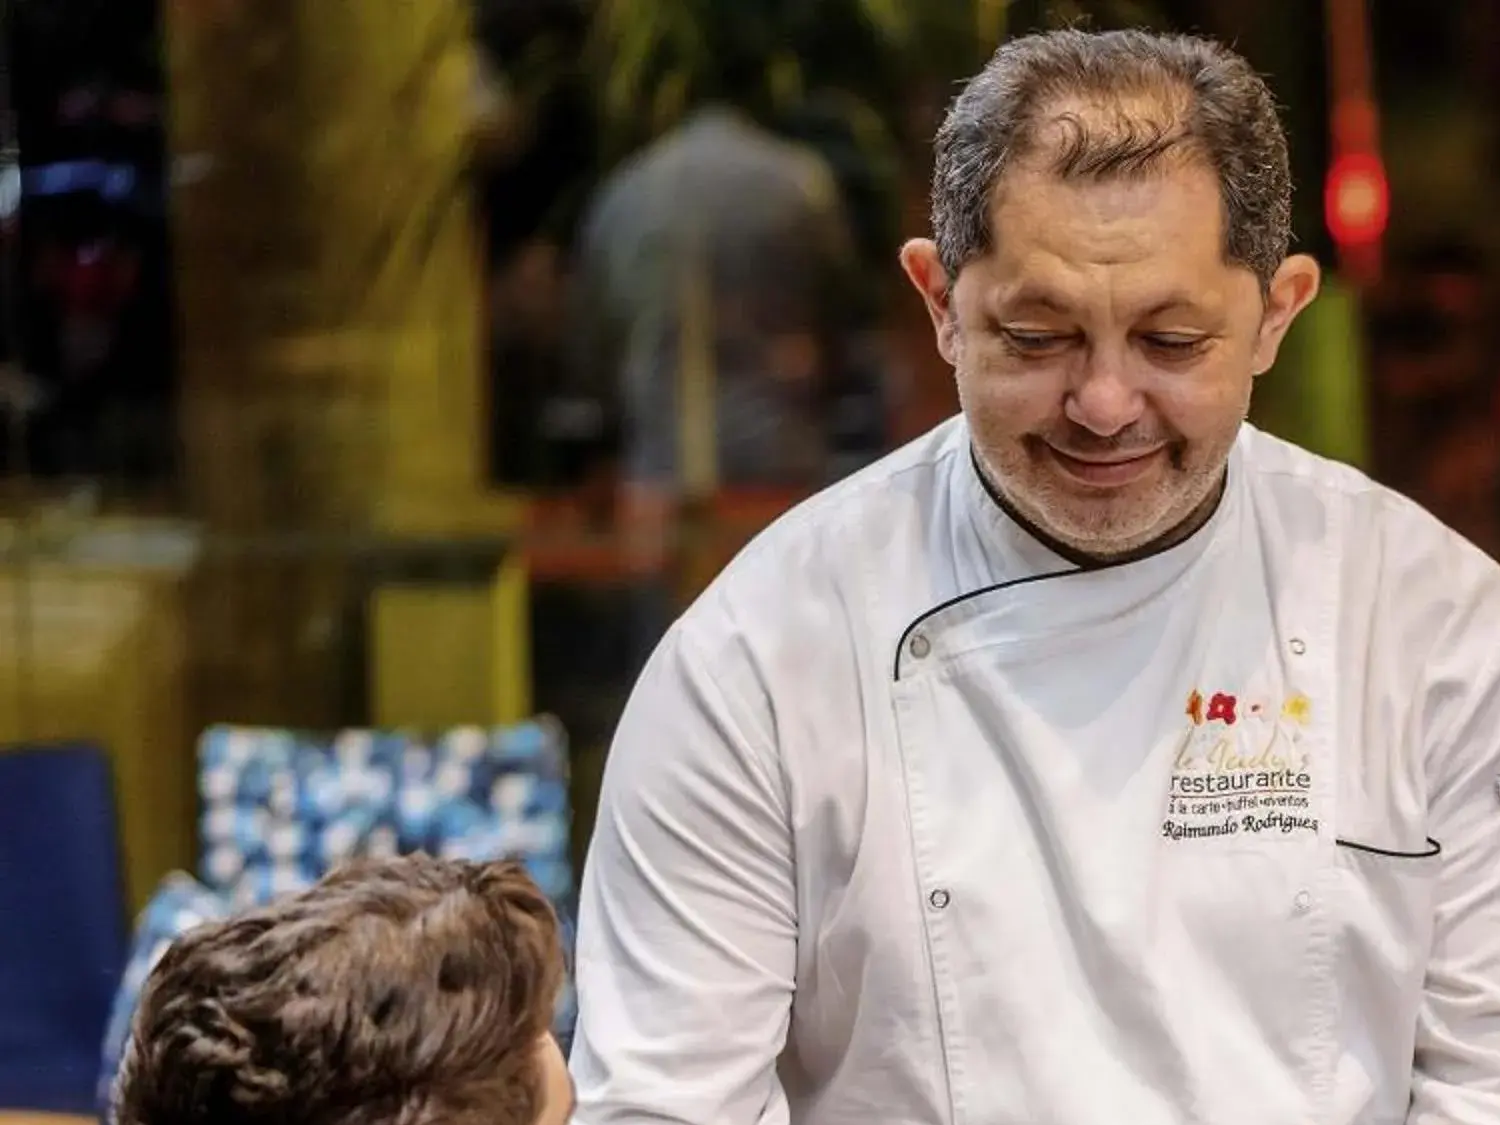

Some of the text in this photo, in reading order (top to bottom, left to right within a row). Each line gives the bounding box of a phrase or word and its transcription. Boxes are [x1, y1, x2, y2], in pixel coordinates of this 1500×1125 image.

[1170, 769, 1311, 792] restaurante
[1163, 810, 1319, 840] Raimundo Rodrigues
